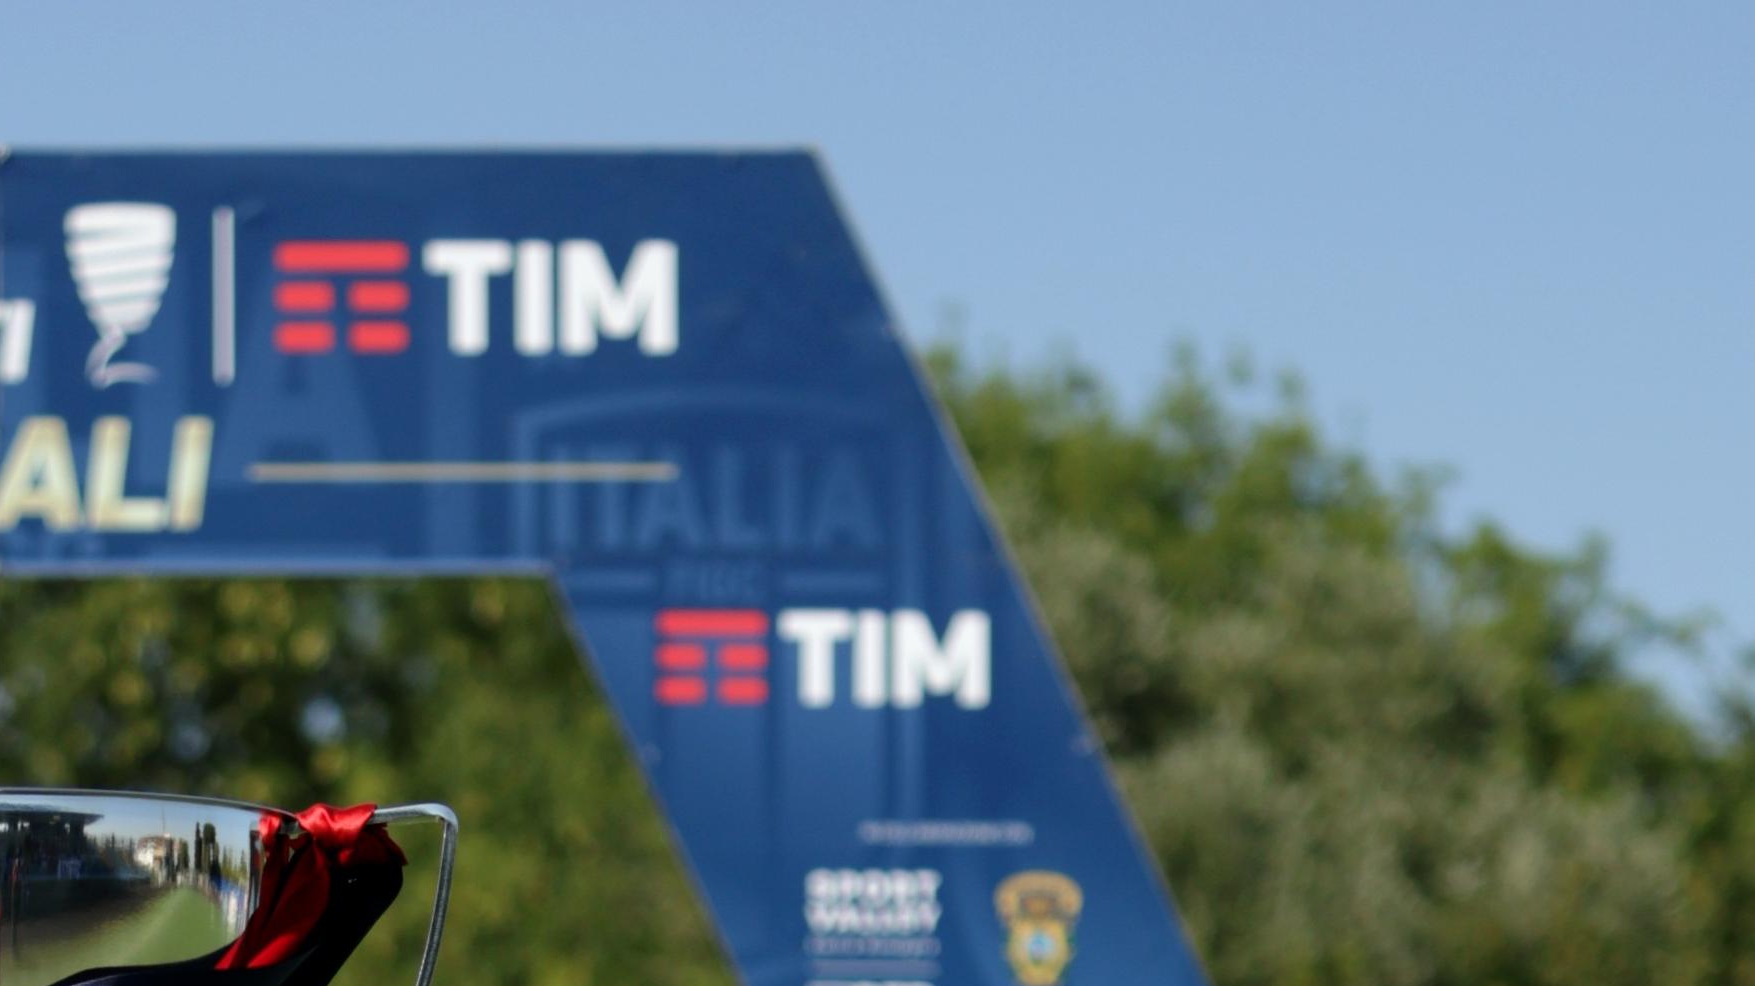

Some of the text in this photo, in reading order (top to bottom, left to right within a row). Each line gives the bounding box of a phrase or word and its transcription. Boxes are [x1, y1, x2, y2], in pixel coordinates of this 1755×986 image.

[422, 239, 680, 357] TIM
[551, 445, 886, 548] ITALIA
[777, 608, 991, 710] TIM
